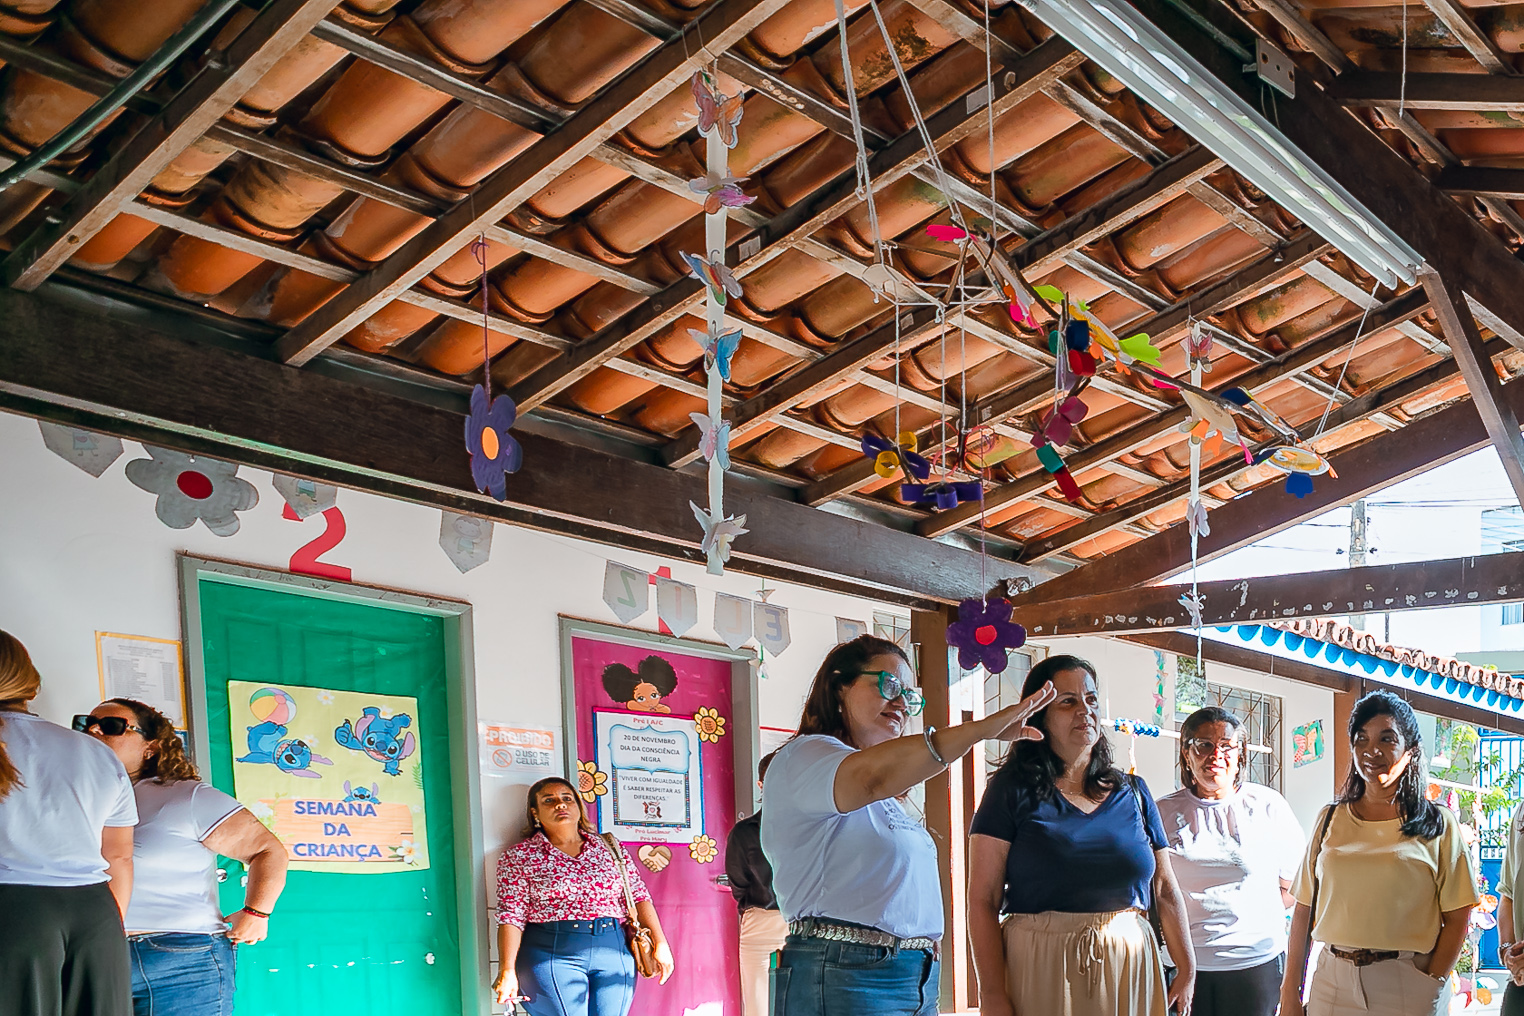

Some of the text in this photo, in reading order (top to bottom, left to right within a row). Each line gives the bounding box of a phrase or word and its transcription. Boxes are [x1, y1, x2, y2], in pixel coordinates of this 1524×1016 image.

[282, 501, 352, 582] 2
[488, 730, 552, 747] PROIBIDO
[641, 736, 676, 745] NOVEMBRO
[515, 749, 521, 757] O
[522, 750, 538, 759] USO
[642, 746, 680, 755] CONSCIÊNCIA
[515, 757, 550, 767] CELULAR
[652, 777, 683, 785] IGUALDADE
[293, 800, 378, 817] SEMANA
[323, 822, 352, 837] DA
[293, 842, 383, 863] CRIANÇA
